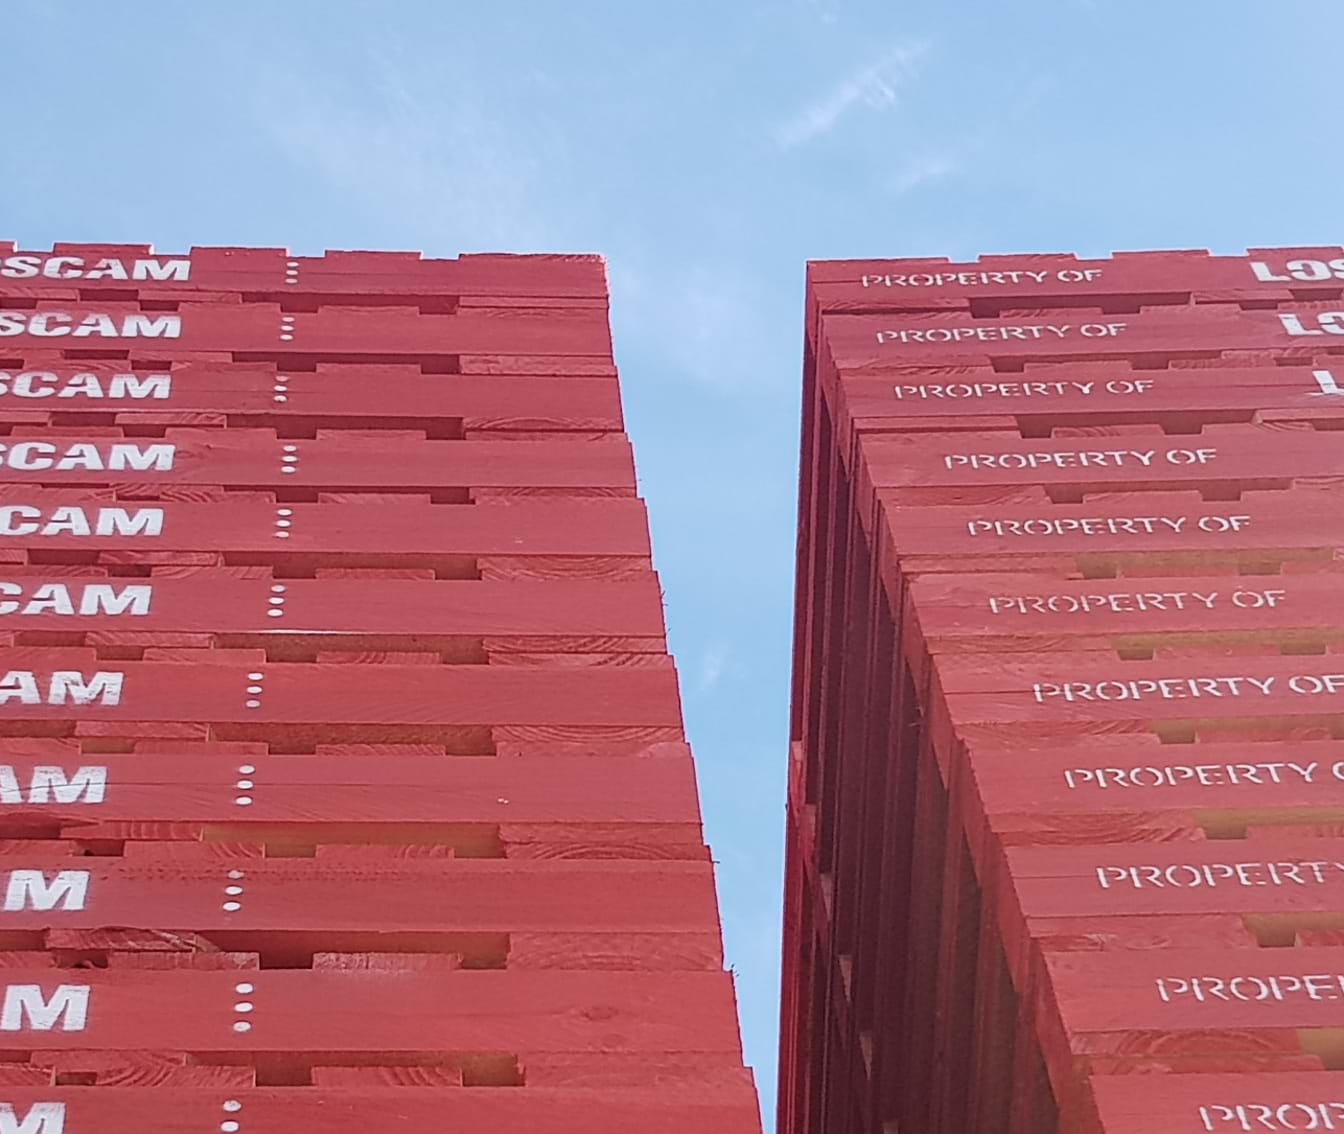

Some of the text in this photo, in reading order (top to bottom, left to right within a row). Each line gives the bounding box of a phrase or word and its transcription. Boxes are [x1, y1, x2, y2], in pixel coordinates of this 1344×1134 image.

[862, 270, 1047, 287] PROPERTY
[1058, 270, 1101, 281] OF
[877, 325, 1070, 343] PROPERTY
[1081, 323, 1126, 336] OF
[895, 383, 1093, 398] PROPERTY
[1107, 380, 1153, 393] OF
[945, 451, 1154, 468] PROPERTY
[1167, 449, 1216, 463] OF
[969, 518, 1185, 535] PROPERTY
[1199, 516, 1250, 531] OF
[990, 593, 1217, 613] PROPERTY
[1233, 590, 1285, 607] OF
[1034, 677, 1274, 701] PROPERTY
[1289, 675, 1344, 693] OF
[1065, 763, 1317, 787] PROPERTY
